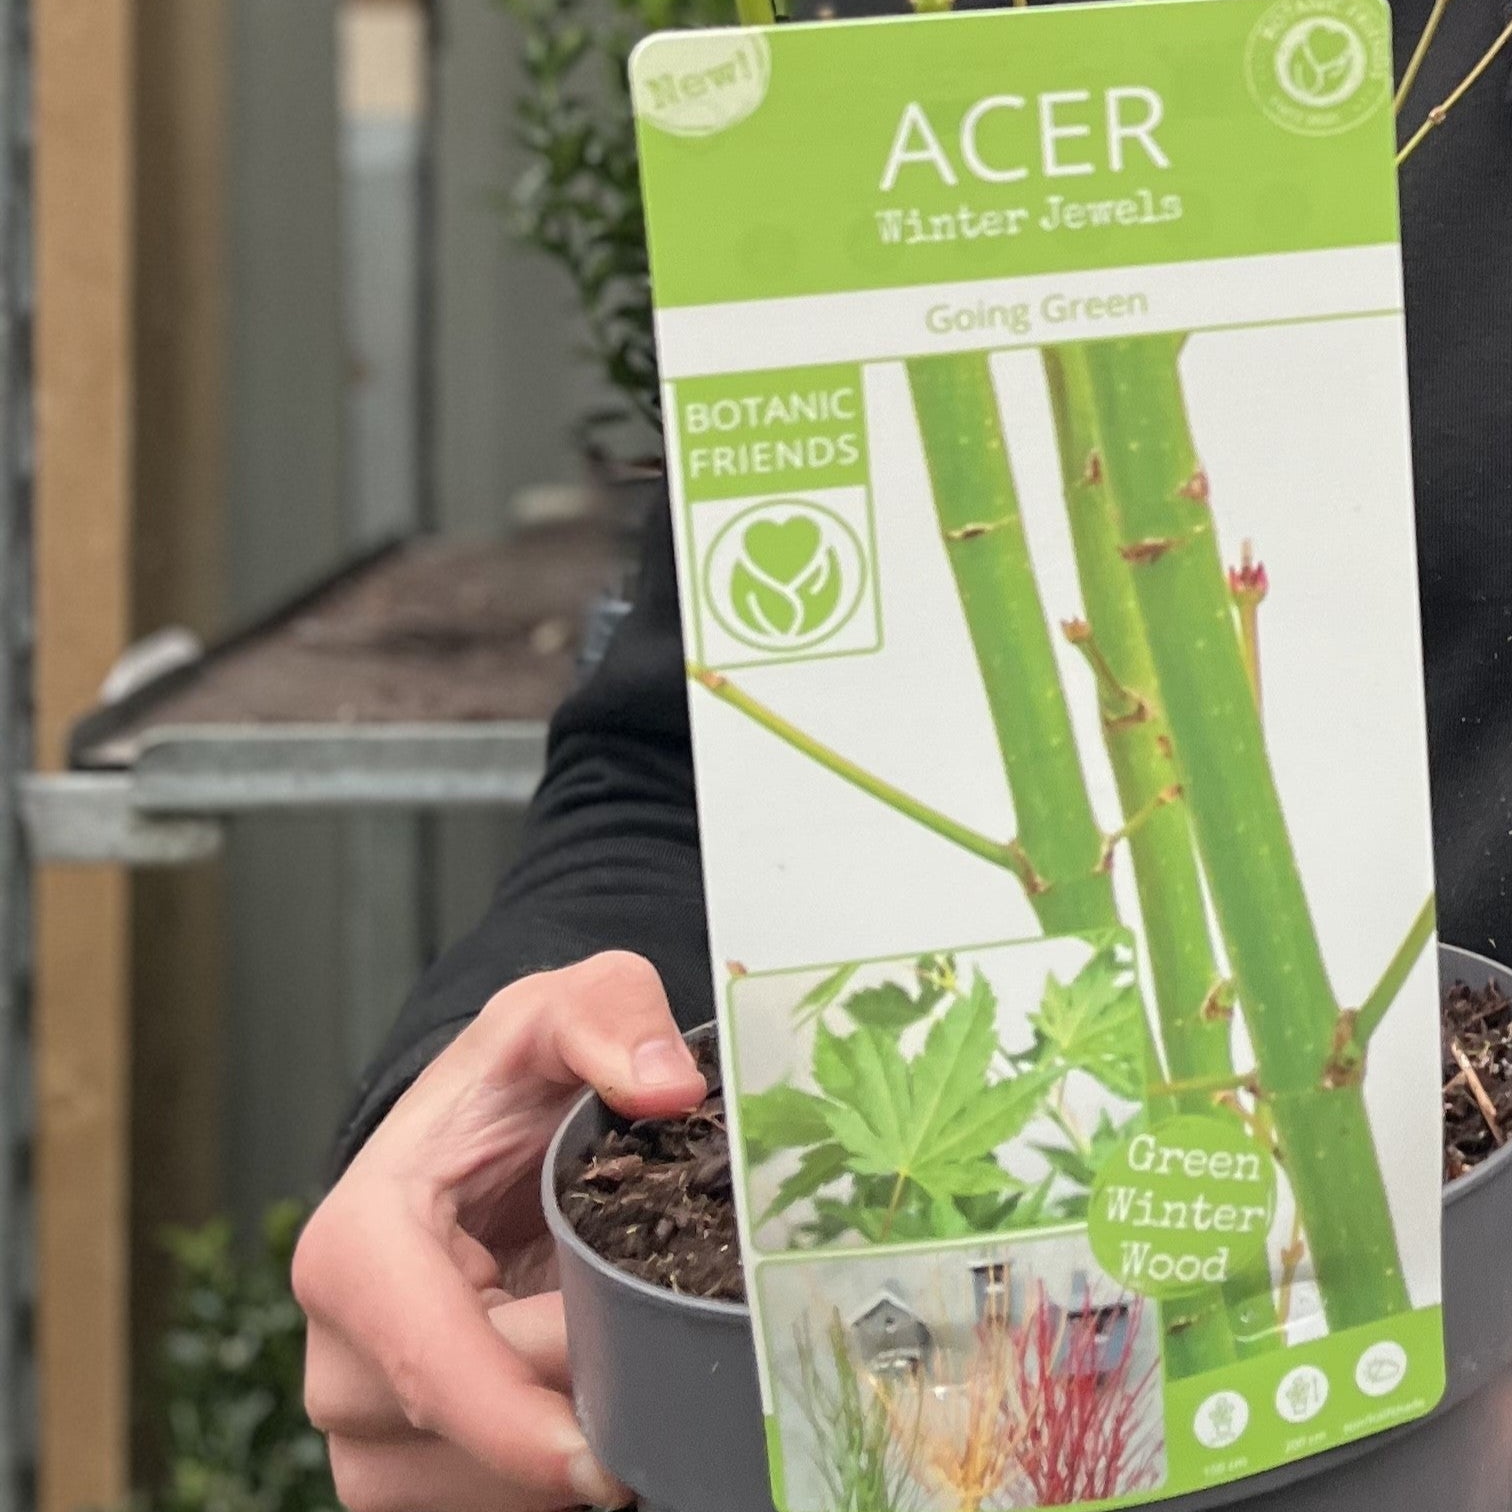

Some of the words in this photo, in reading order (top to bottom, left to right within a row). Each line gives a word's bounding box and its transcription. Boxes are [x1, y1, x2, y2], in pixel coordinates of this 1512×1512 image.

[879, 85, 1170, 191] ACER
[875, 205, 1029, 245] Winter
[1038, 189, 1183, 231] Jewels
[925, 299, 1031, 334] Going
[1040, 292, 1149, 323] Green
[685, 388, 856, 434] BOTANIC
[690, 433, 860, 479] FRIENDS
[1128, 1133, 1260, 1181] Green
[1107, 1185, 1266, 1233] Winter
[1120, 1240, 1230, 1282] Wood
